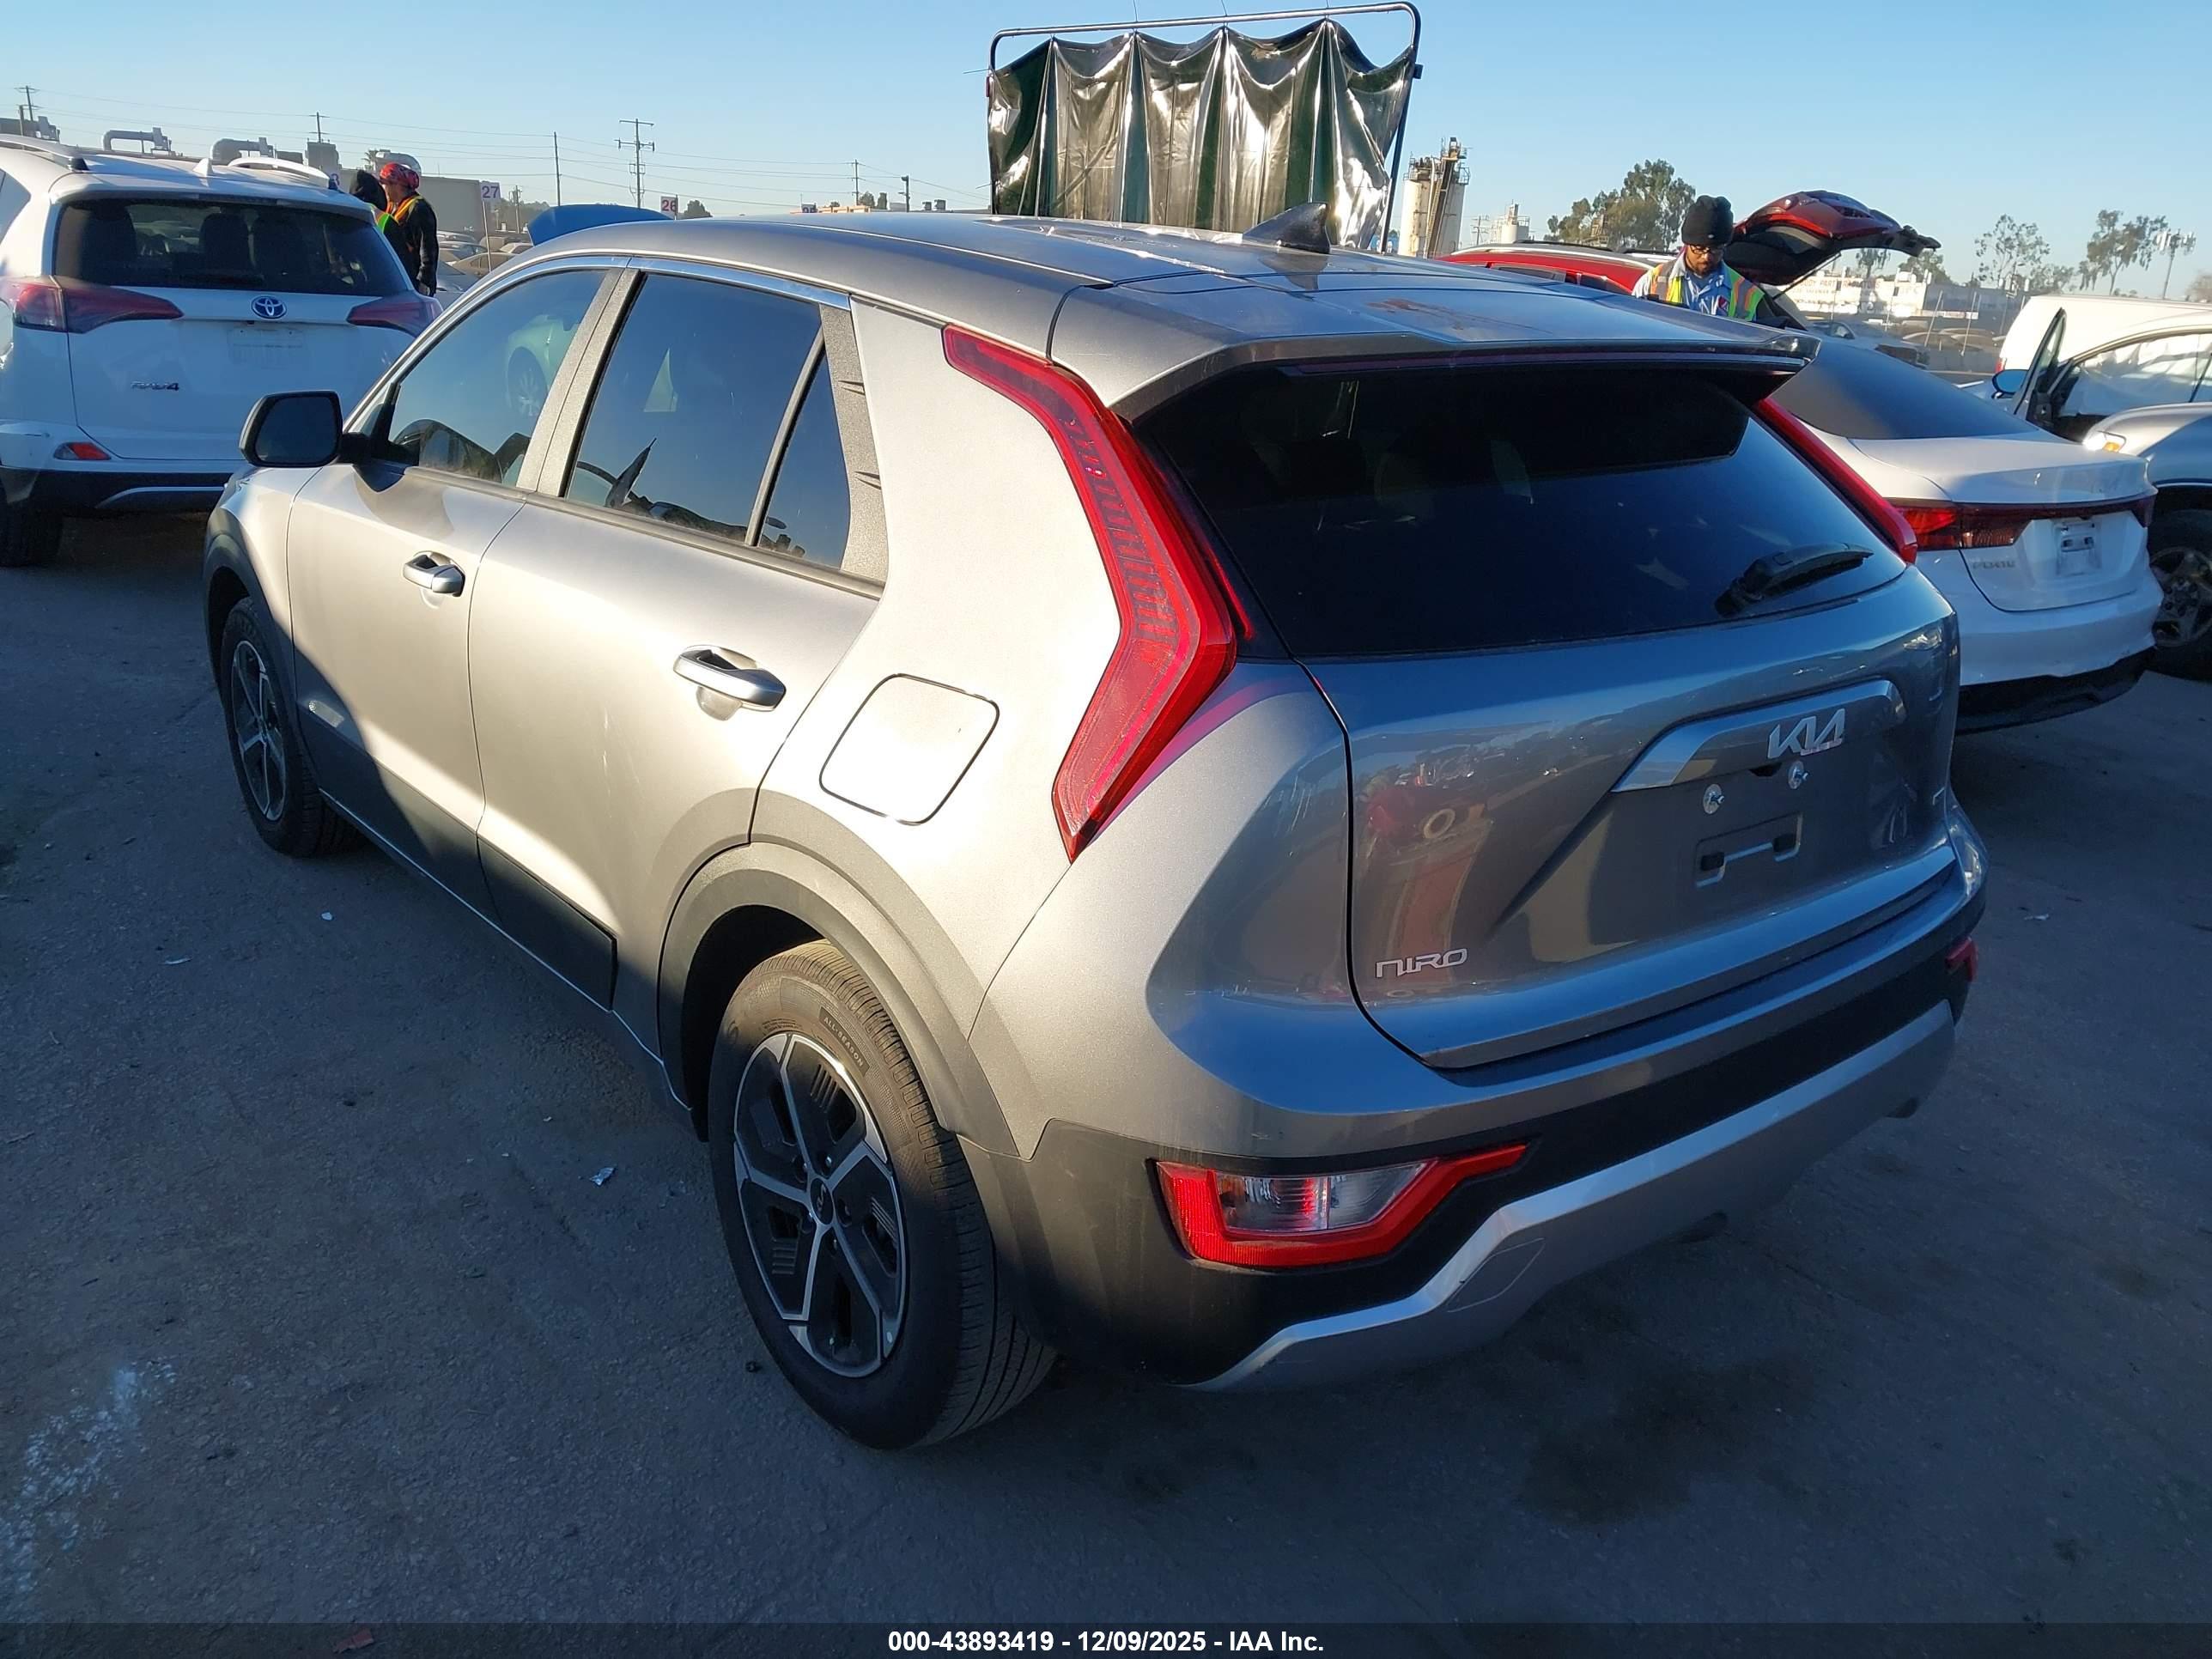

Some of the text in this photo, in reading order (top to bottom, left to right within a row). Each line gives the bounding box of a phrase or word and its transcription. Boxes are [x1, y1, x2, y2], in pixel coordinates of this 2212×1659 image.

[482, 185, 499, 198] 27
[131, 381, 179, 391] RAV4
[1768, 708, 1845, 759] KIA
[1376, 948, 1468, 978] NIRO
[823, 1017, 864, 1067] ALL-SEASON
